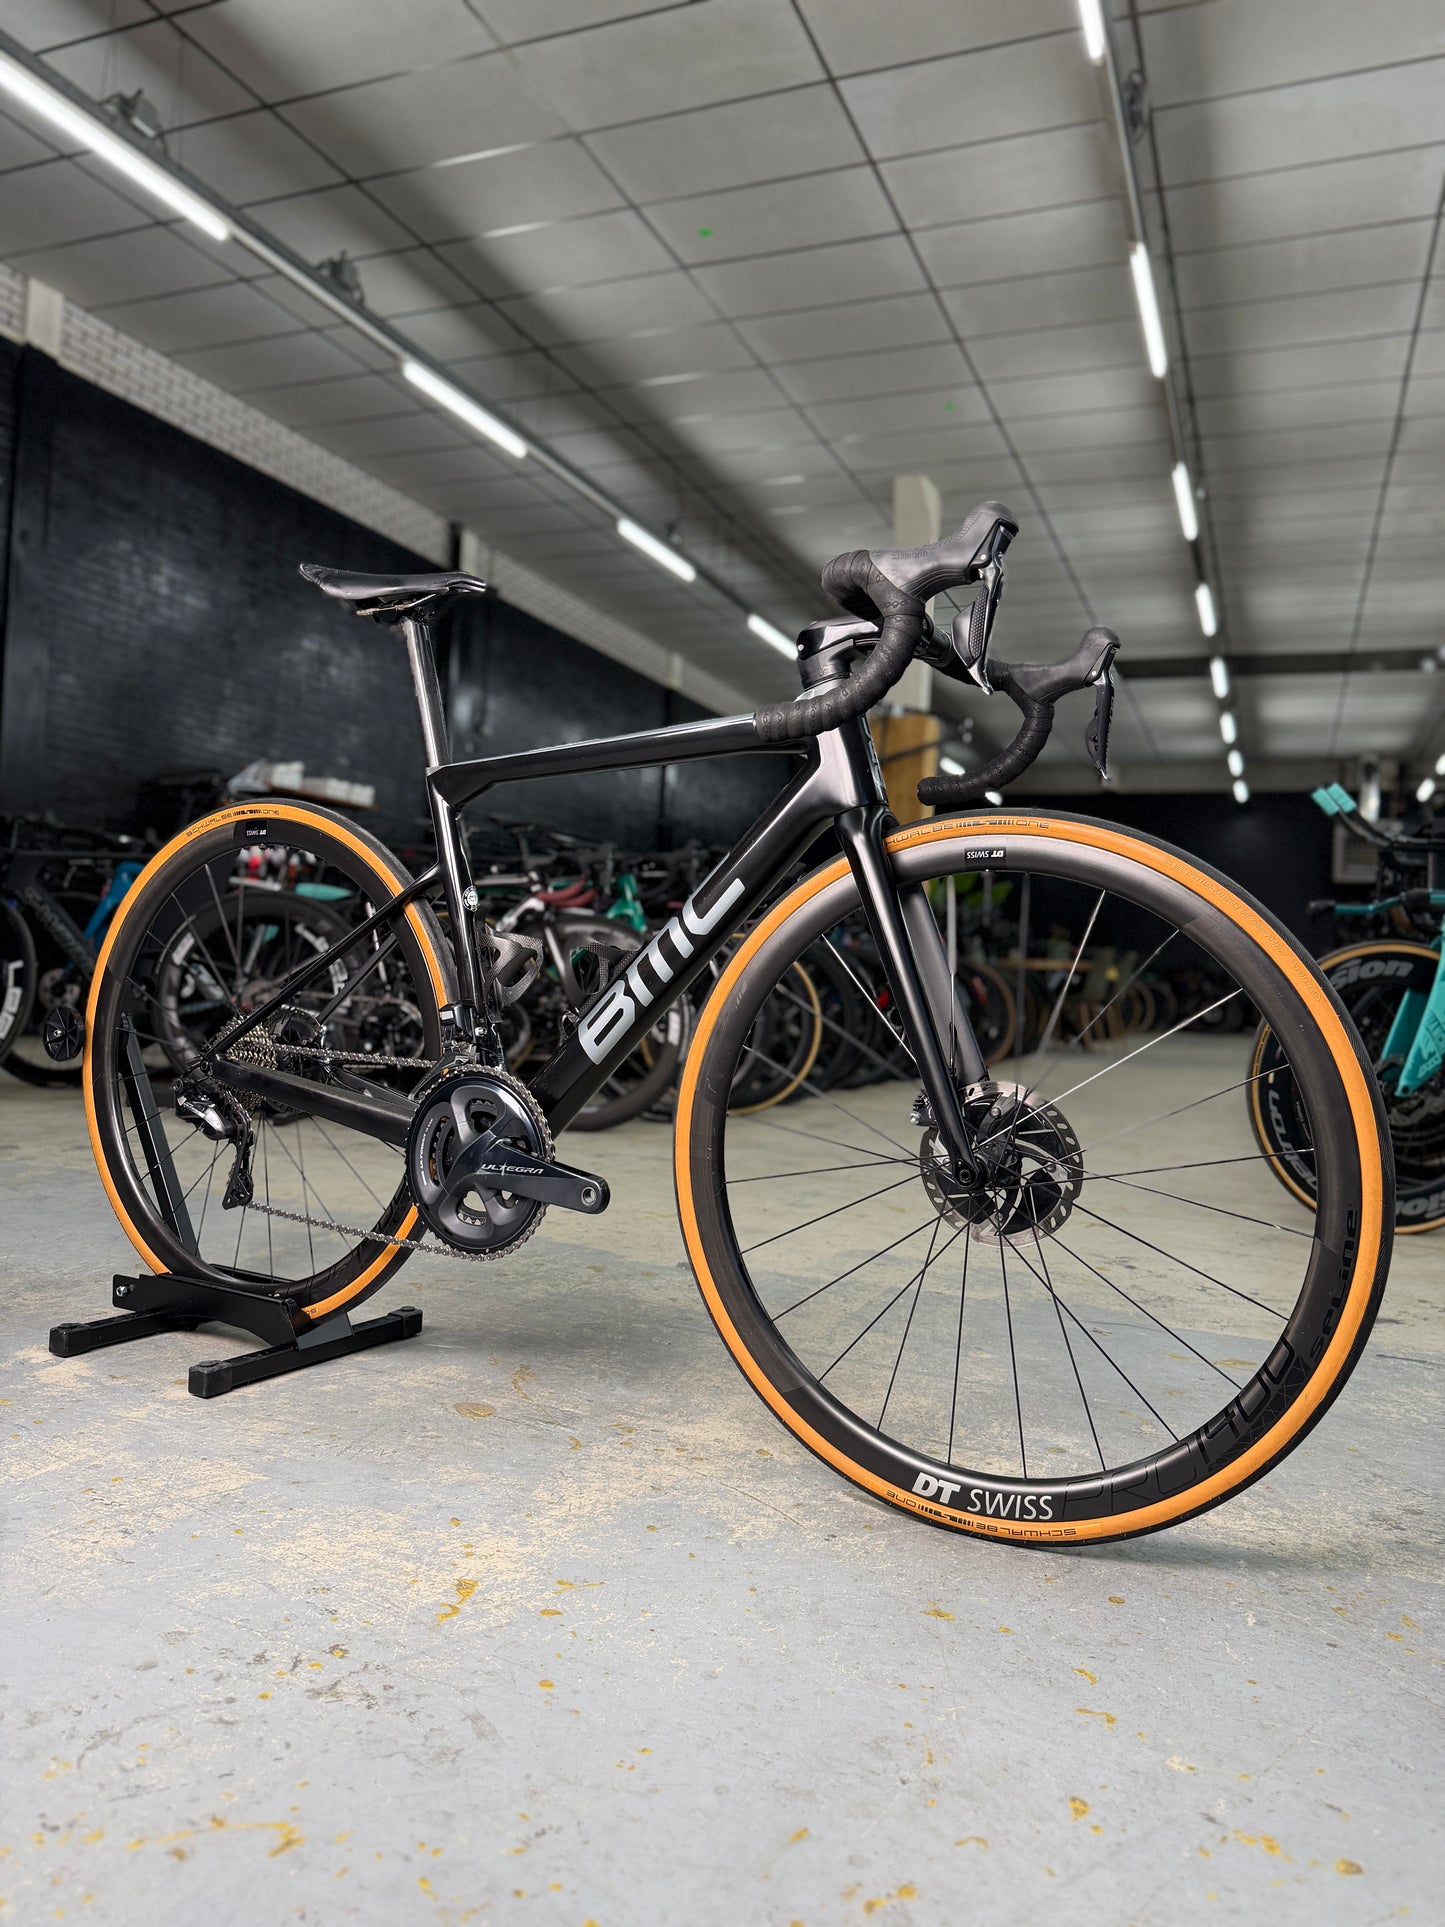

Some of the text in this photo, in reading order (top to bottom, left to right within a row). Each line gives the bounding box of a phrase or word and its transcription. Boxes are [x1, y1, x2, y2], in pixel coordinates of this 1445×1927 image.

[885, 822, 954, 846] HWALBE
[966, 850, 1004, 860] DT SWISS
[578, 851, 746, 1066] BMC
[1328, 958, 1415, 991] sion
[481, 1160, 544, 1177] ULTEGRA
[911, 1472, 962, 1505] DT
[967, 1488, 1054, 1521] SWISS
[1061, 1441, 1198, 1520] PRC
[886, 1489, 1077, 1537] ONE SCHWALBE
